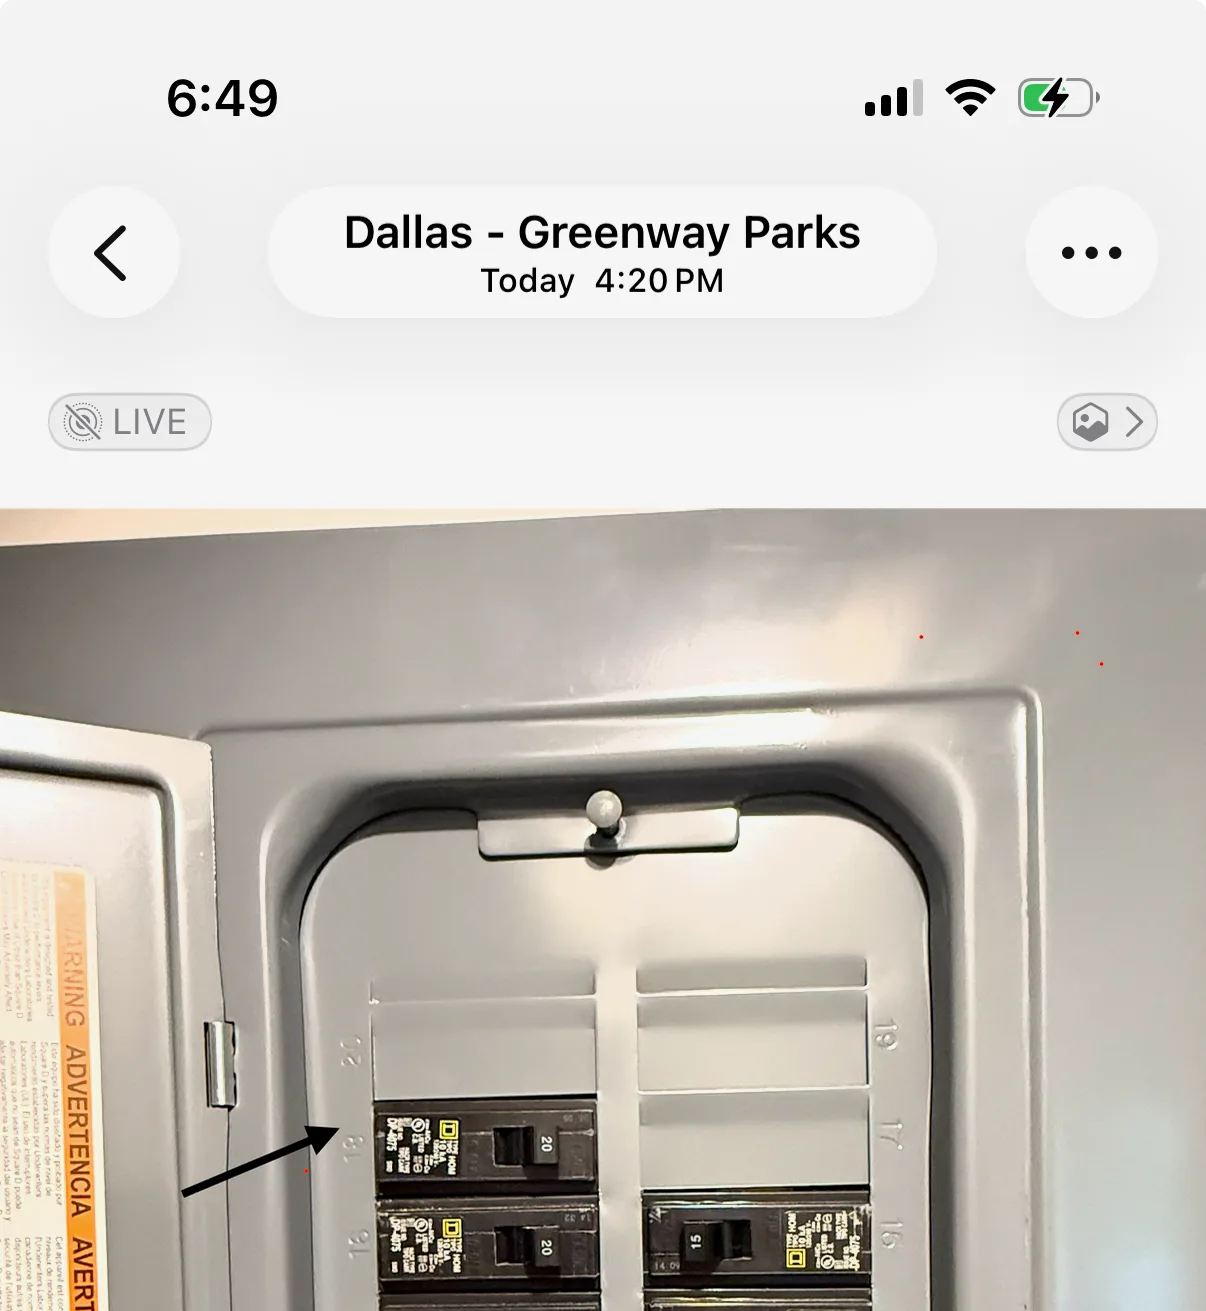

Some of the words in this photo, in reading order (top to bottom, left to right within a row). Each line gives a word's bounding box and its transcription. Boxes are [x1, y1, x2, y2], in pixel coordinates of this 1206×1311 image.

[168, 79, 277, 117] 6:49
[347, 214, 472, 249] Dallas
[519, 215, 730, 257] Greenway
[746, 214, 860, 249] Parks
[481, 267, 574, 298] Today
[596, 268, 667, 293] 4:20
[677, 268, 722, 292] PM
[115, 409, 185, 434] LIVE
[875, 1018, 899, 1051] 19
[66, 1045, 92, 1217] ADVERTENCIA
[879, 1118, 904, 1151] 17
[438, 1140, 448, 1152] 10
[541, 1136, 553, 1153] 20
[448, 1156, 456, 1175] HOM
[788, 1213, 796, 1232] HOM
[441, 1238, 450, 1251] 10
[541, 1239, 553, 1256] 20
[690, 1234, 702, 1249] 15
[797, 1236, 807, 1248] 10
[453, 1254, 461, 1273] HOM
